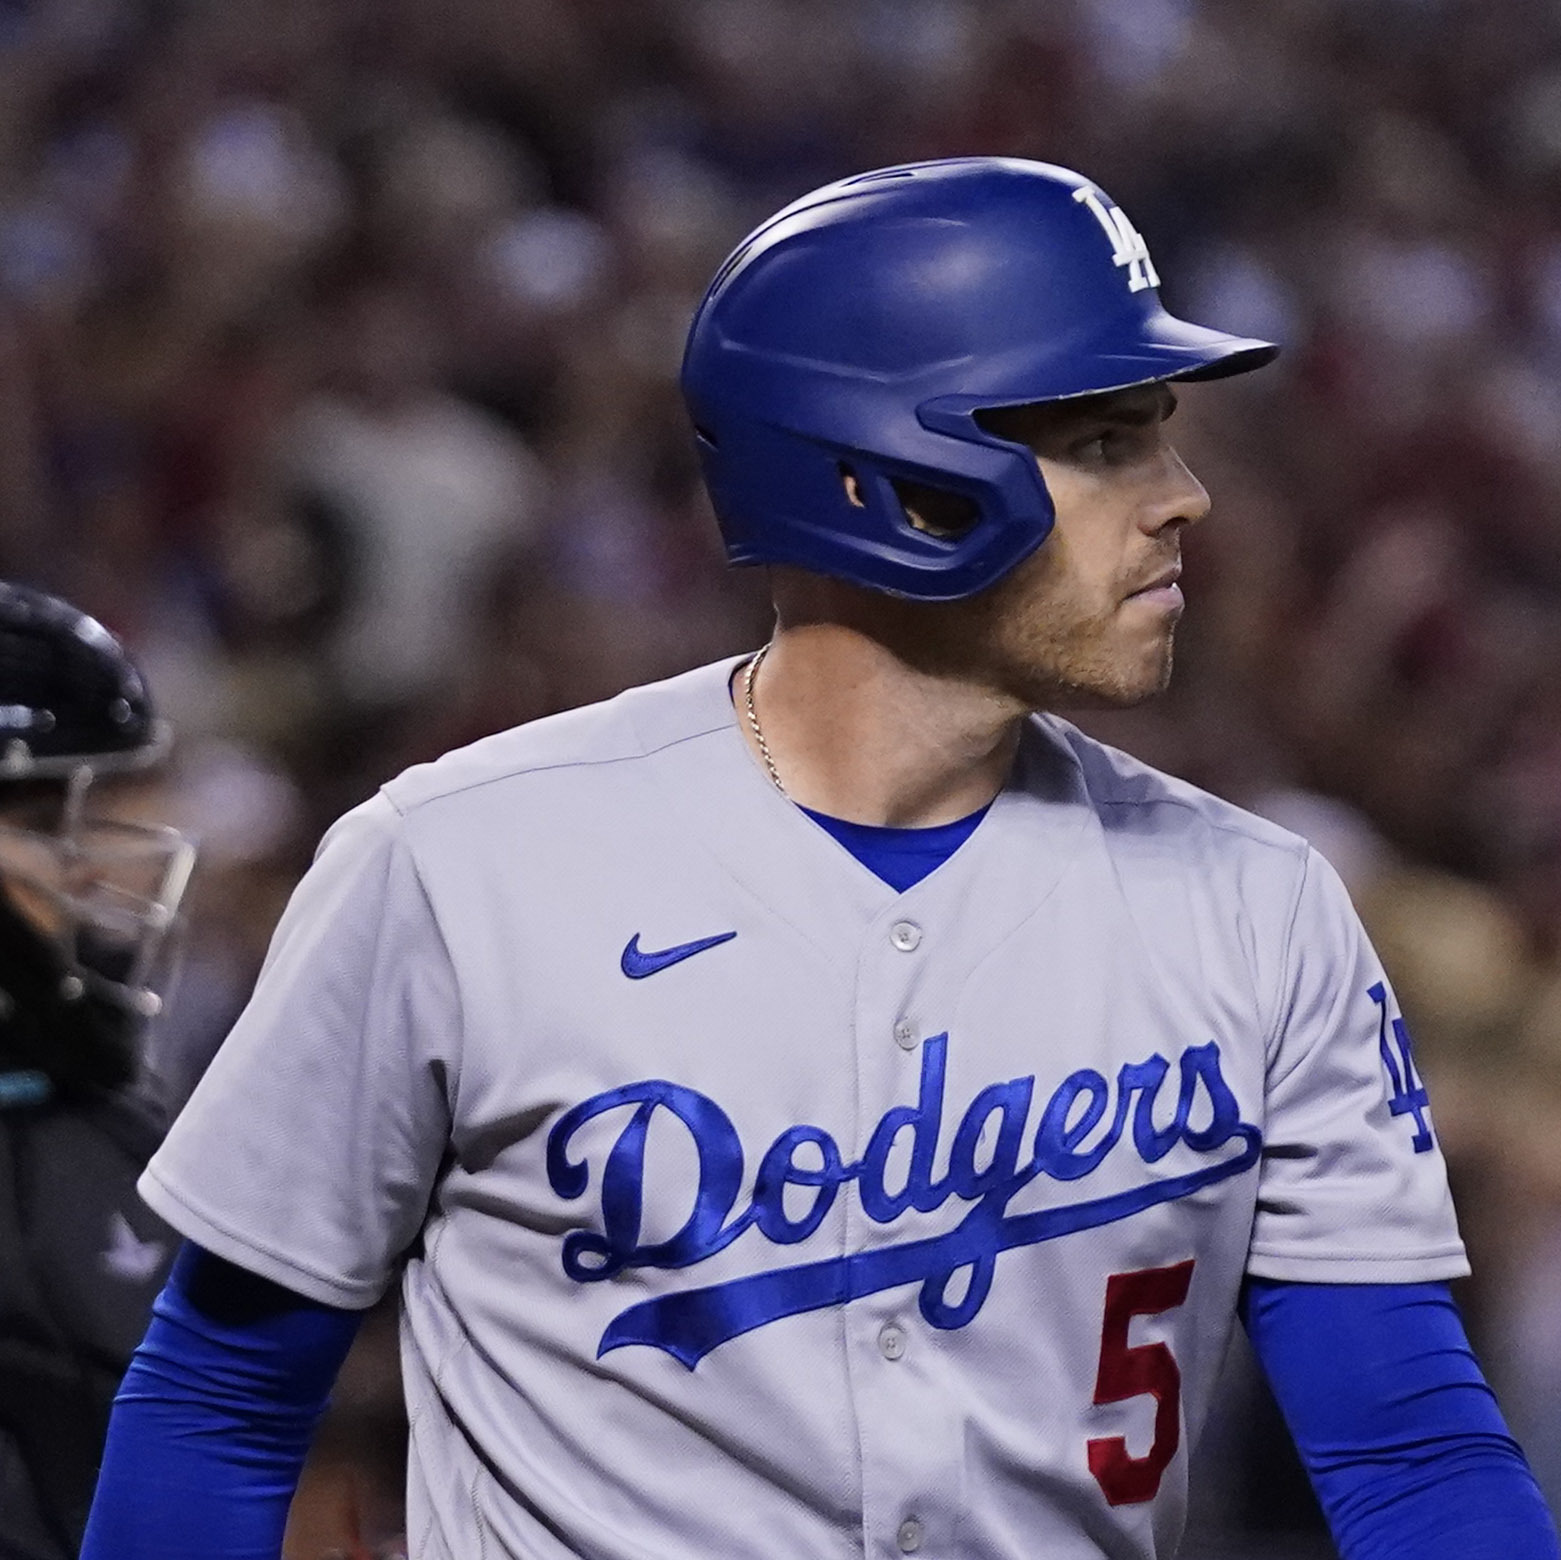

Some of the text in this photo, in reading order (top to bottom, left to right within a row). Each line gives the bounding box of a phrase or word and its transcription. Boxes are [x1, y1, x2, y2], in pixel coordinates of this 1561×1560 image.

[1072, 185, 1161, 293] LA
[547, 1034, 1258, 1331] Dodgers
[1087, 1260, 1196, 1507] 5
